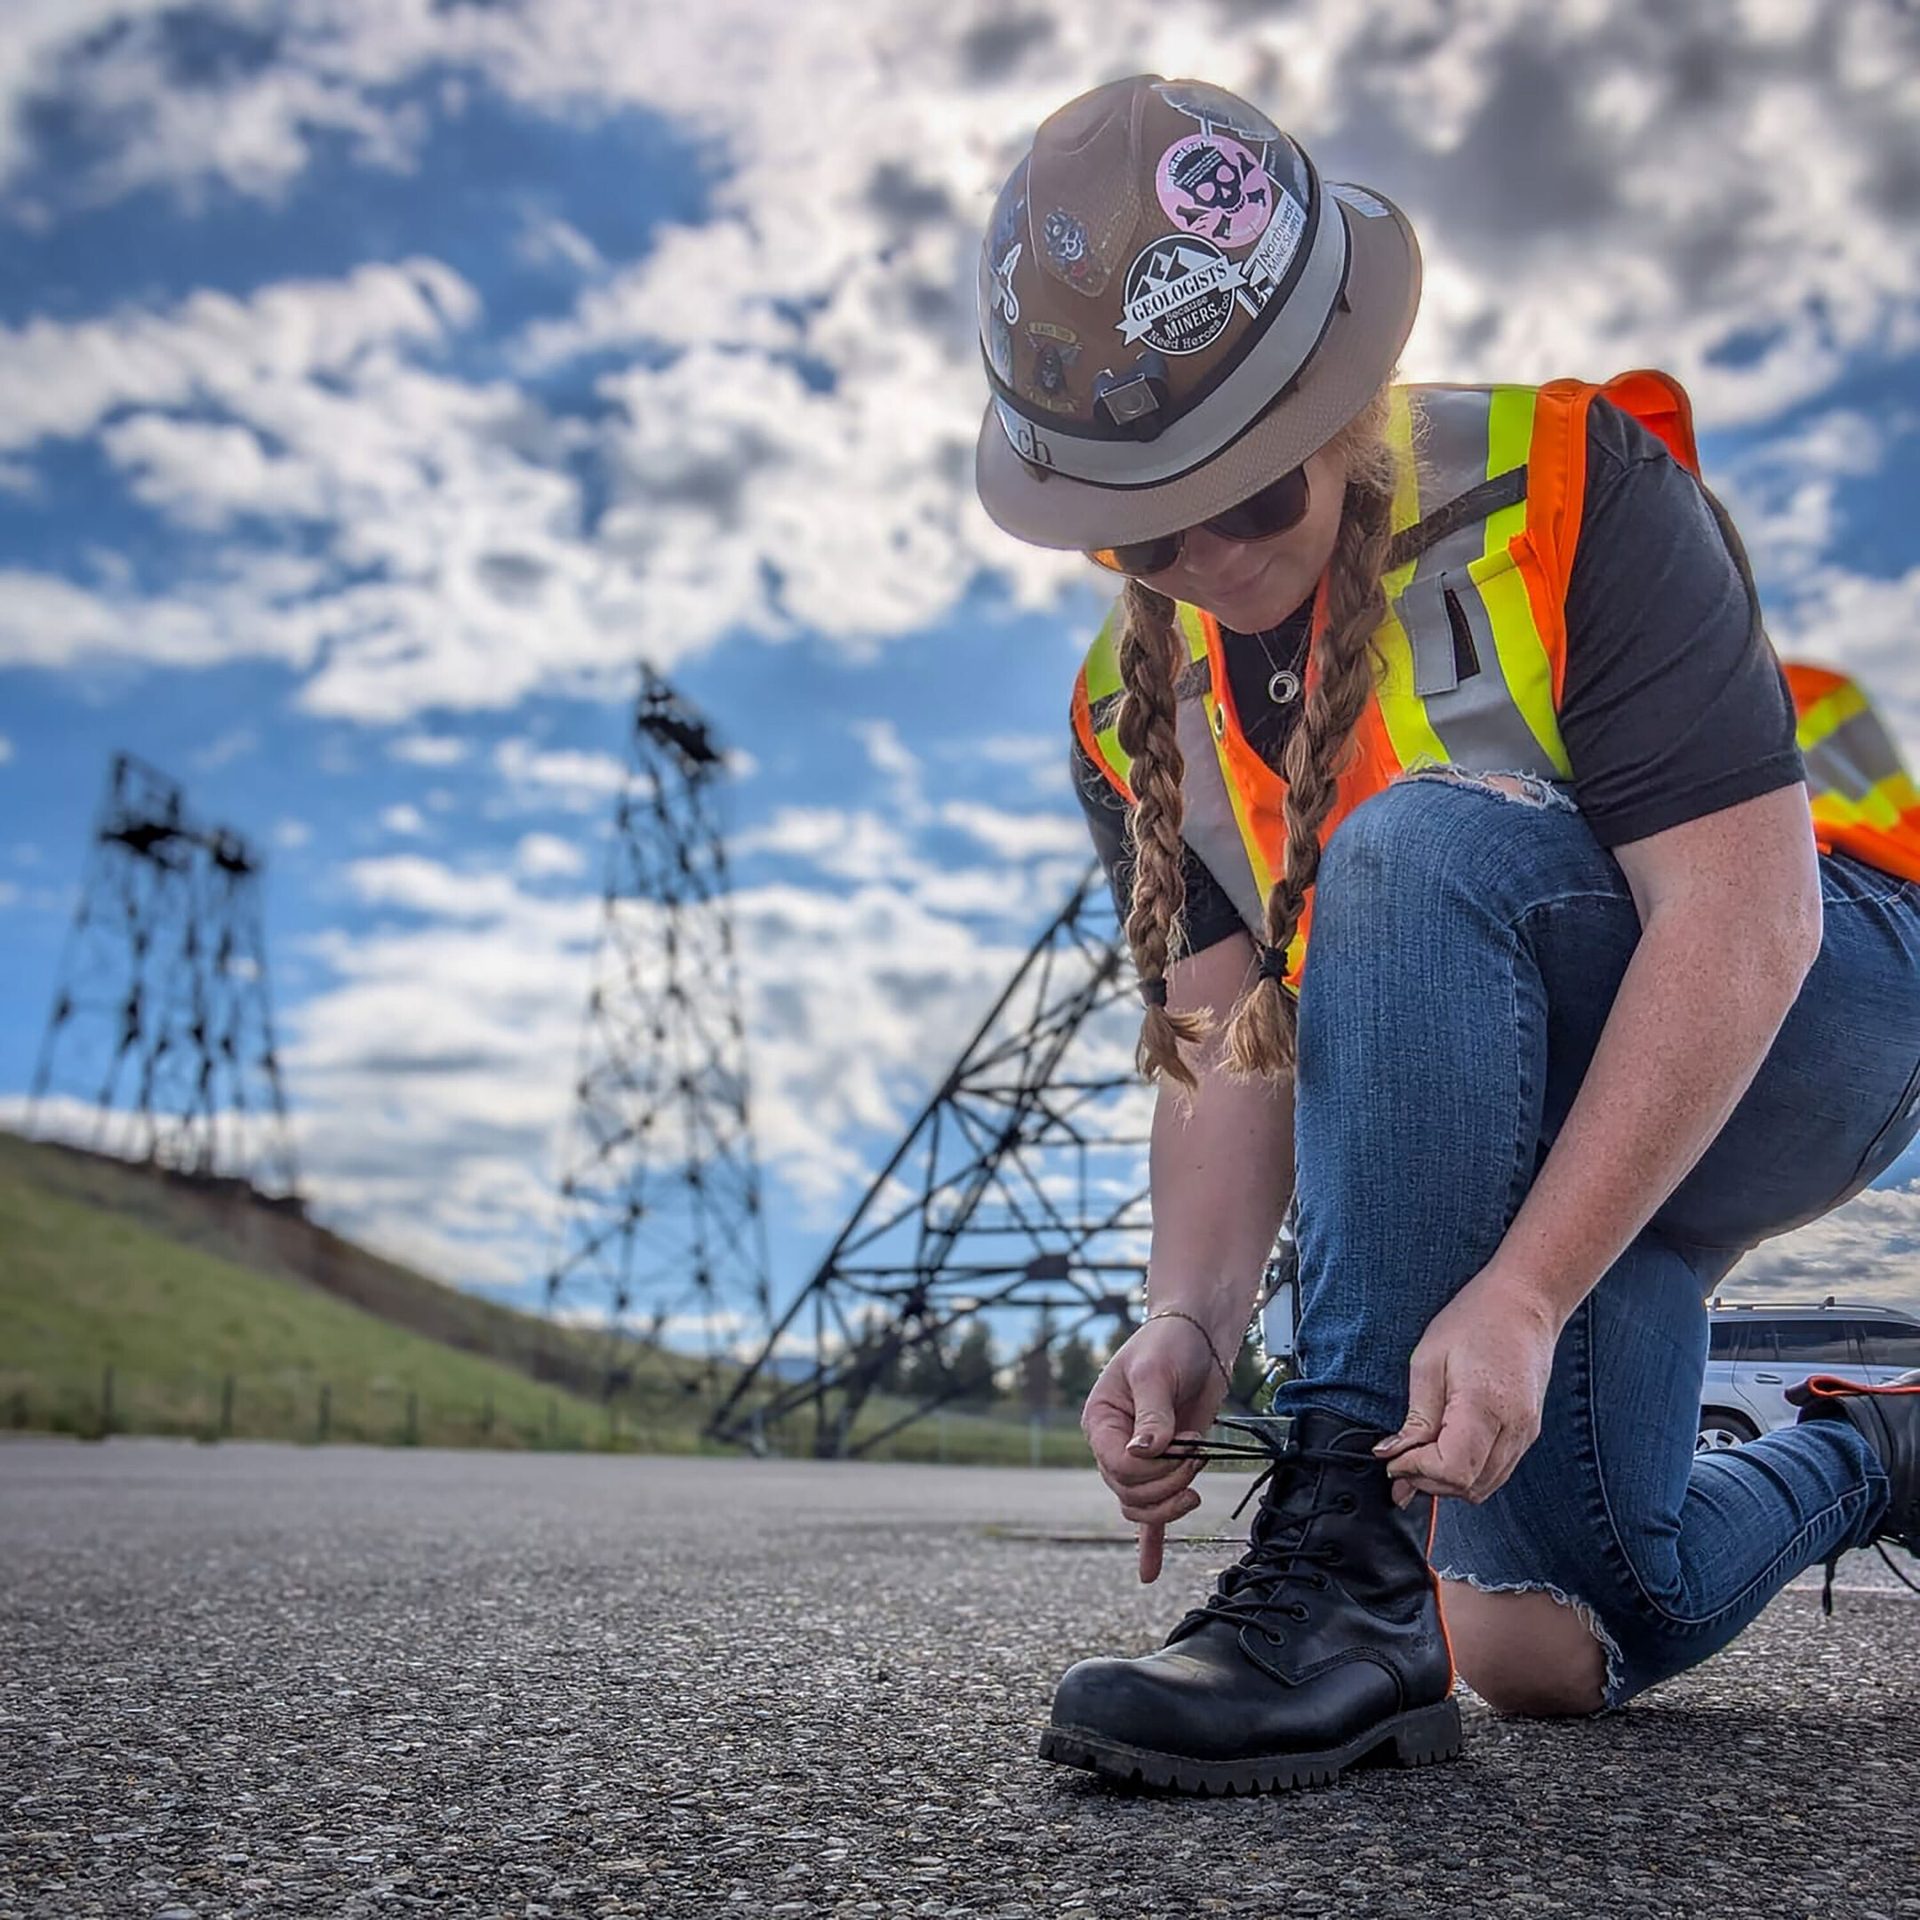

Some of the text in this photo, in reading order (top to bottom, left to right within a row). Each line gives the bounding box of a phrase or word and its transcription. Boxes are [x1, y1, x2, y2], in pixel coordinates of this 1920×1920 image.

[1259, 201, 1295, 262] Northwest
[1268, 244, 1286, 274] MINE
[1131, 262, 1227, 322] GEOLOGISTS
[1164, 303, 1217, 340] MINERS
[1165, 296, 1209, 322] Because
[1148, 330, 1180, 350] Need
[1183, 320, 1221, 350] Heroes
